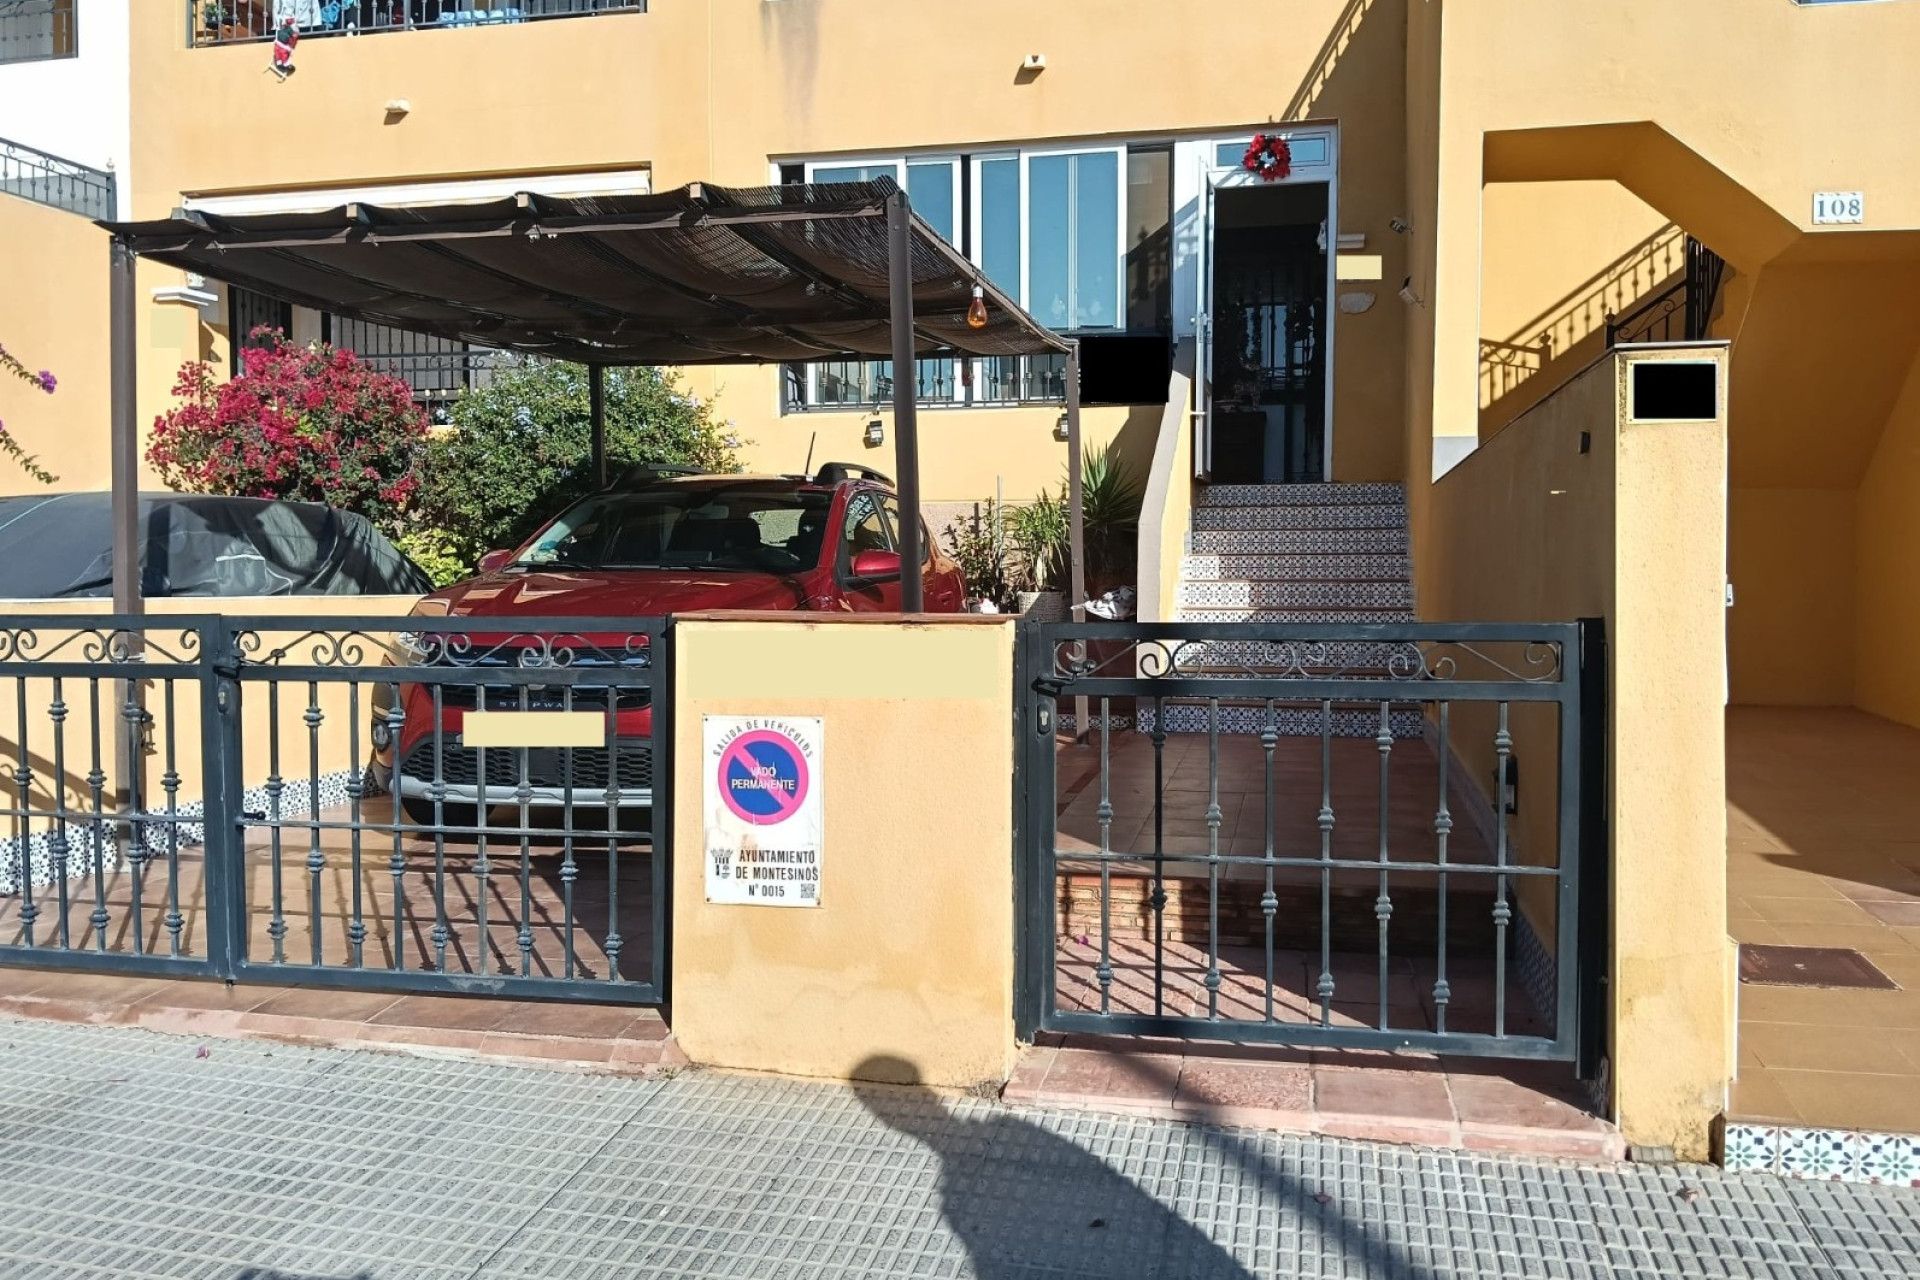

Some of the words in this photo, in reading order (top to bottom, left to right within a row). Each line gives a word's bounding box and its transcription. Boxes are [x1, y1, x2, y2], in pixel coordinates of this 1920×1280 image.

[1818, 199, 1860, 217] 108
[713, 725, 742, 757] SALIDA
[746, 720, 759, 730] DE
[750, 766, 777, 777] VADO
[731, 778, 795, 790] PERMANENTE
[739, 849, 815, 864] AYUNTAMIENTO
[735, 866, 748, 880] DE
[753, 866, 819, 881] MONTESINOS
[762, 885, 785, 897] 0015
